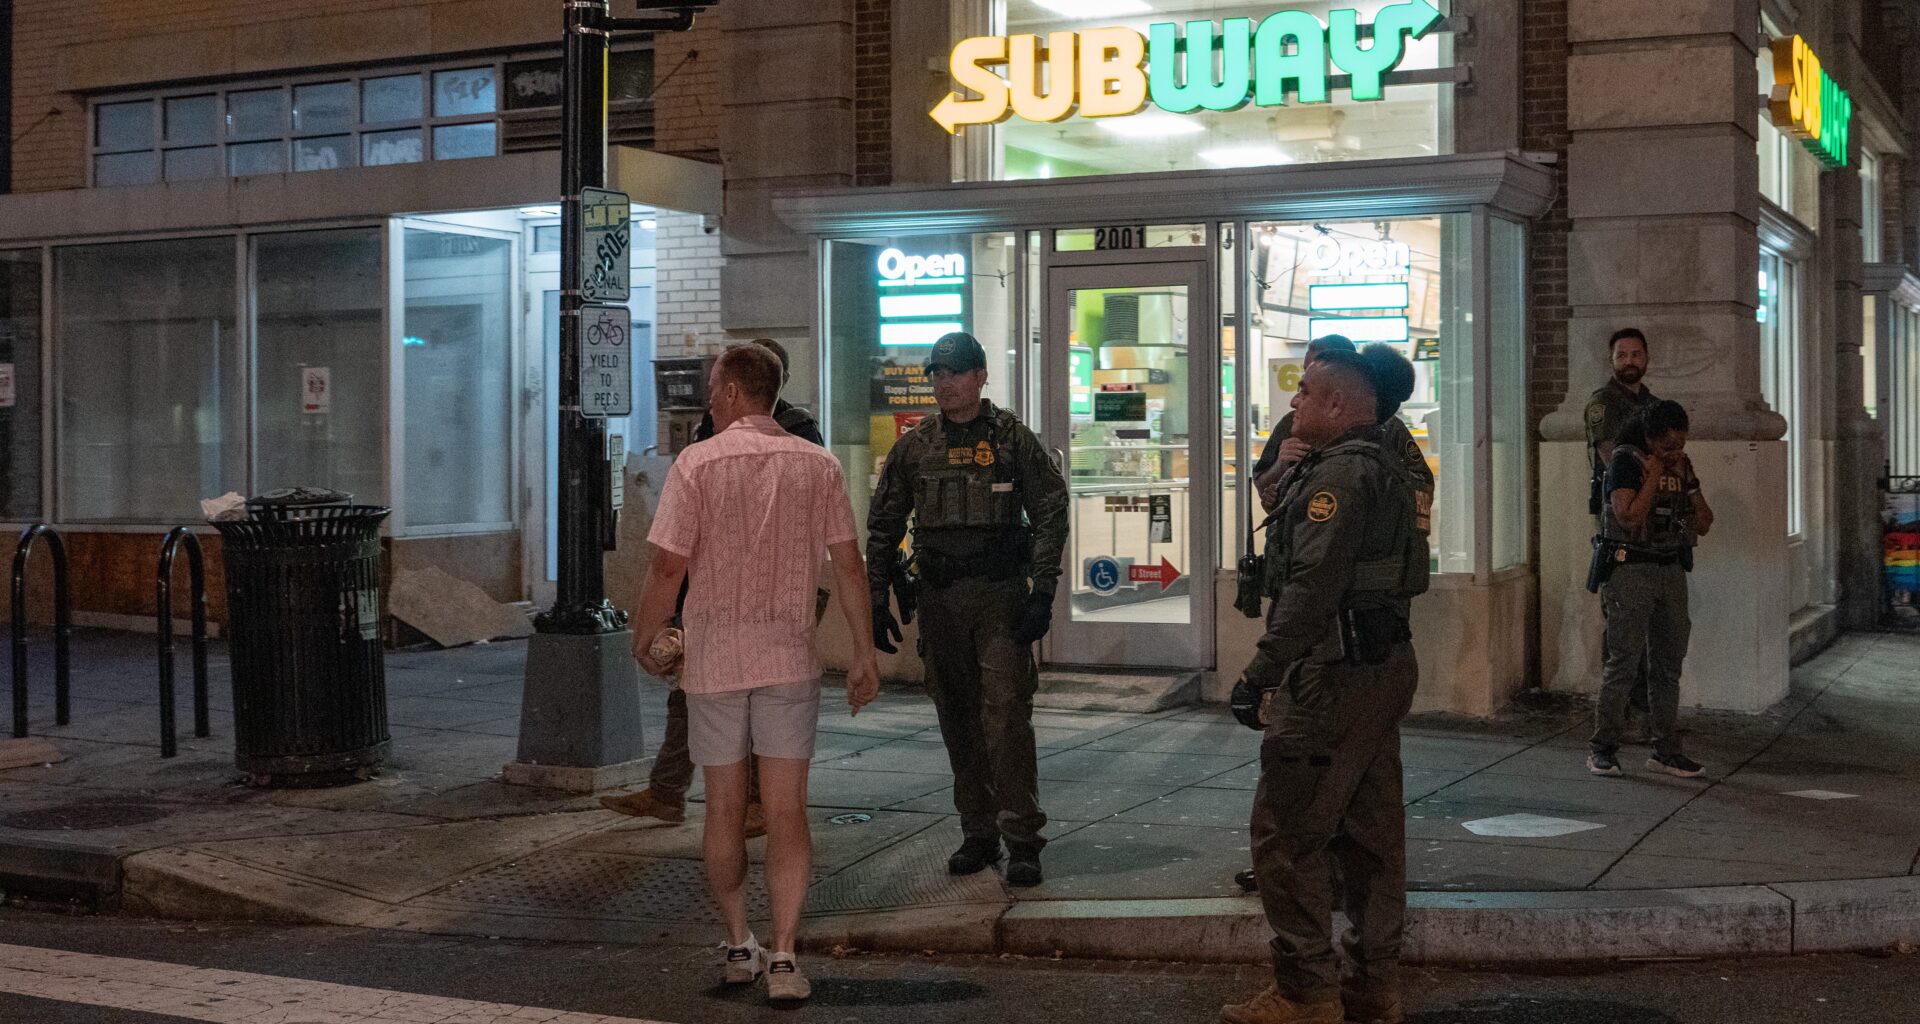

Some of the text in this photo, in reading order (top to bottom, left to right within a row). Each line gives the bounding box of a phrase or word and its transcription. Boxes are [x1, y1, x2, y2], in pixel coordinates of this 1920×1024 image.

[929, 0, 1443, 135] SUBWAY
[1790, 34, 1851, 167] SUBWAY
[1096, 226, 1145, 249] 2001
[1310, 236, 1411, 276] Open
[878, 248, 965, 286] Open
[590, 354, 619, 368] YIELD
[884, 367, 925, 376] BUY ANY
[600, 373, 612, 387] TO
[884, 385, 907, 395] Happy
[889, 396, 938, 405] FOR $1 MO
[1659, 476, 1682, 492] FBI
[1138, 568, 1161, 579] Street
